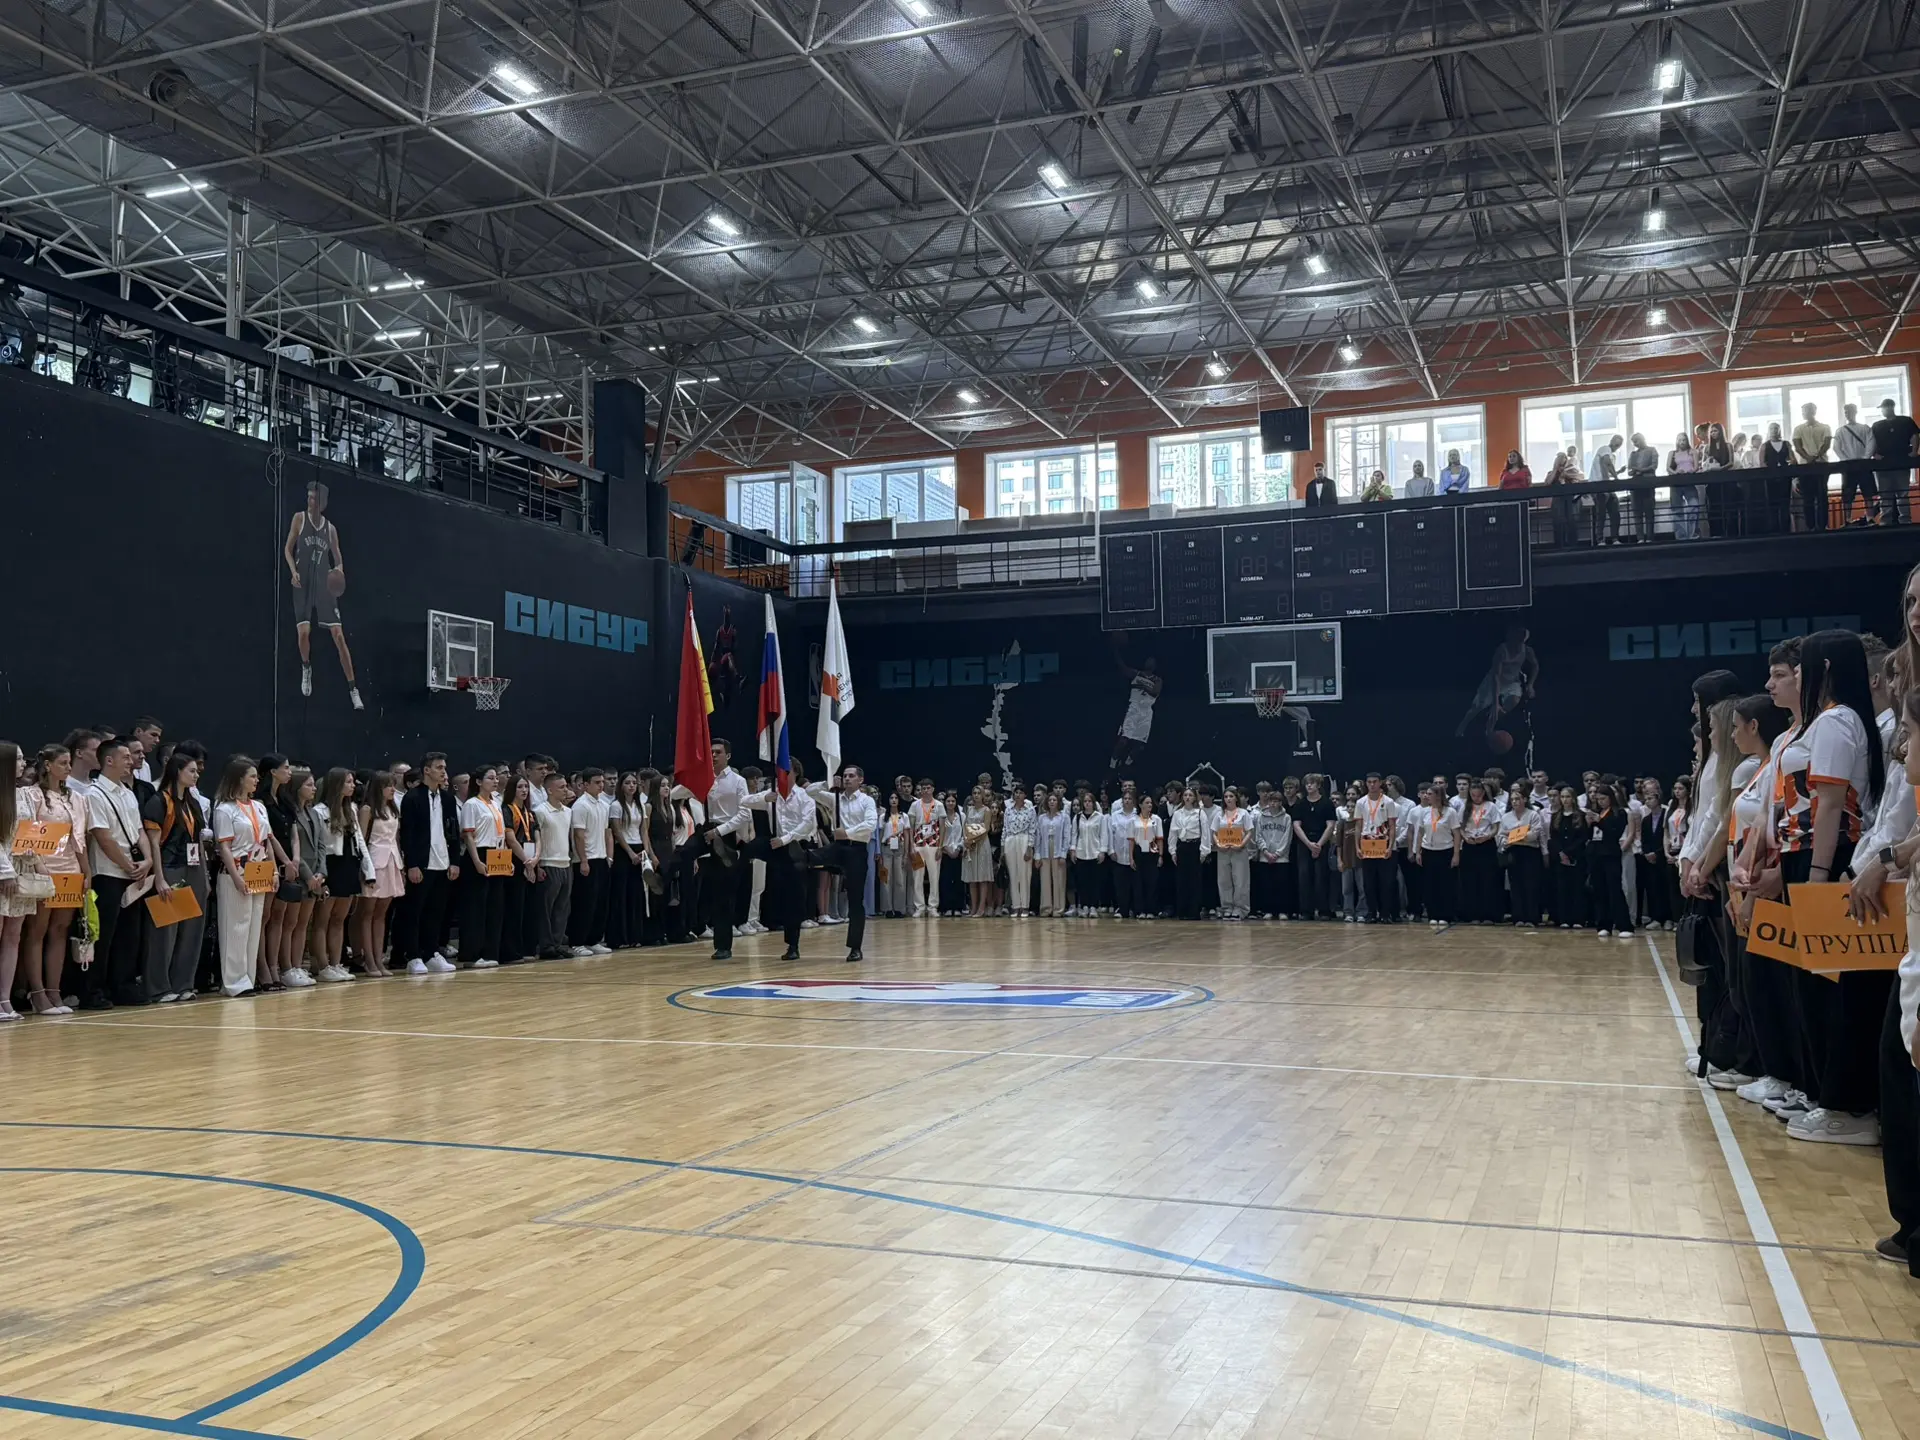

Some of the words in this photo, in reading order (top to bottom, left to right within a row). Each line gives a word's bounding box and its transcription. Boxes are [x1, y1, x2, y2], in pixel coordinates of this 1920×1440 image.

[504, 589, 649, 654] СИБУР
[877, 652, 1060, 689] СИБУР
[40, 825, 47, 835] 6
[14, 838, 58, 851] ГРУПП
[256, 865, 262, 875] 5
[63, 877, 69, 887] 7
